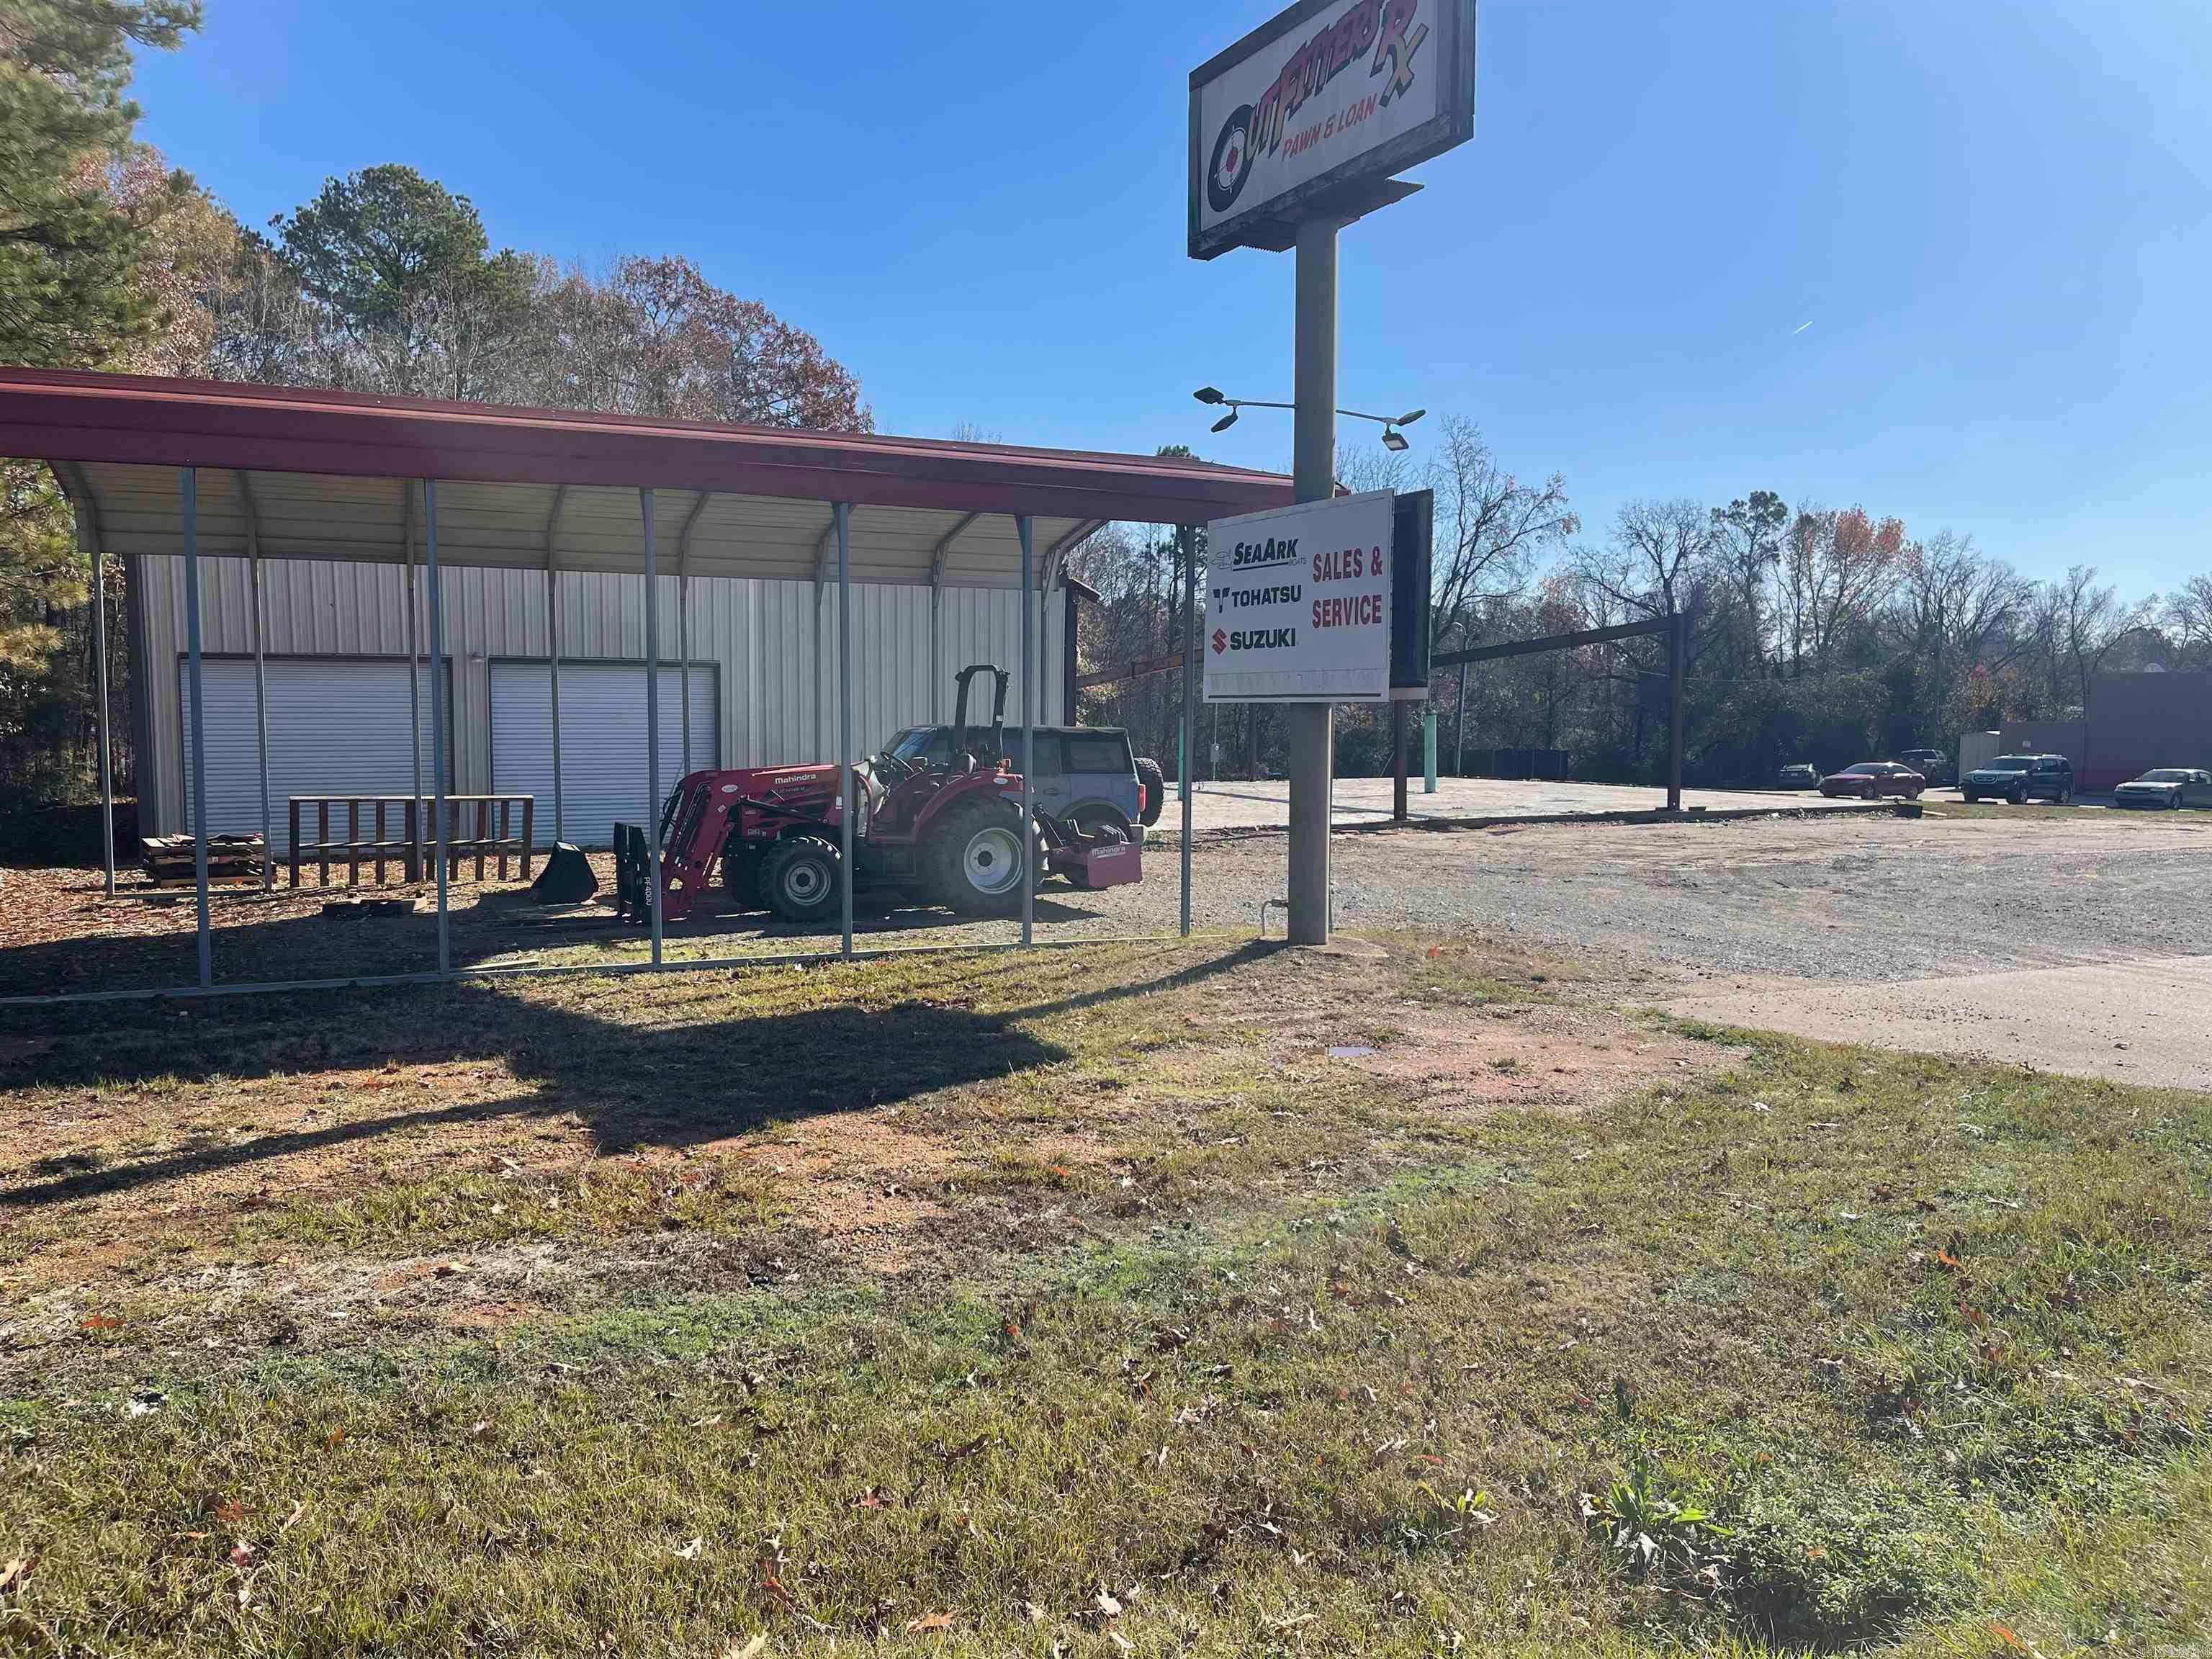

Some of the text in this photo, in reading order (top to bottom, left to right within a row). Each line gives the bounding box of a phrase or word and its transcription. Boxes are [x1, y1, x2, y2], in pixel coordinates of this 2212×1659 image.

[1281, 92, 1377, 162] PAWN & LOAN
[1313, 546, 1383, 583] SALES &
[1231, 585, 1302, 608] TOHATSU
[1312, 594, 1382, 629] SERVICE
[1230, 627, 1296, 651] SUZUKI
